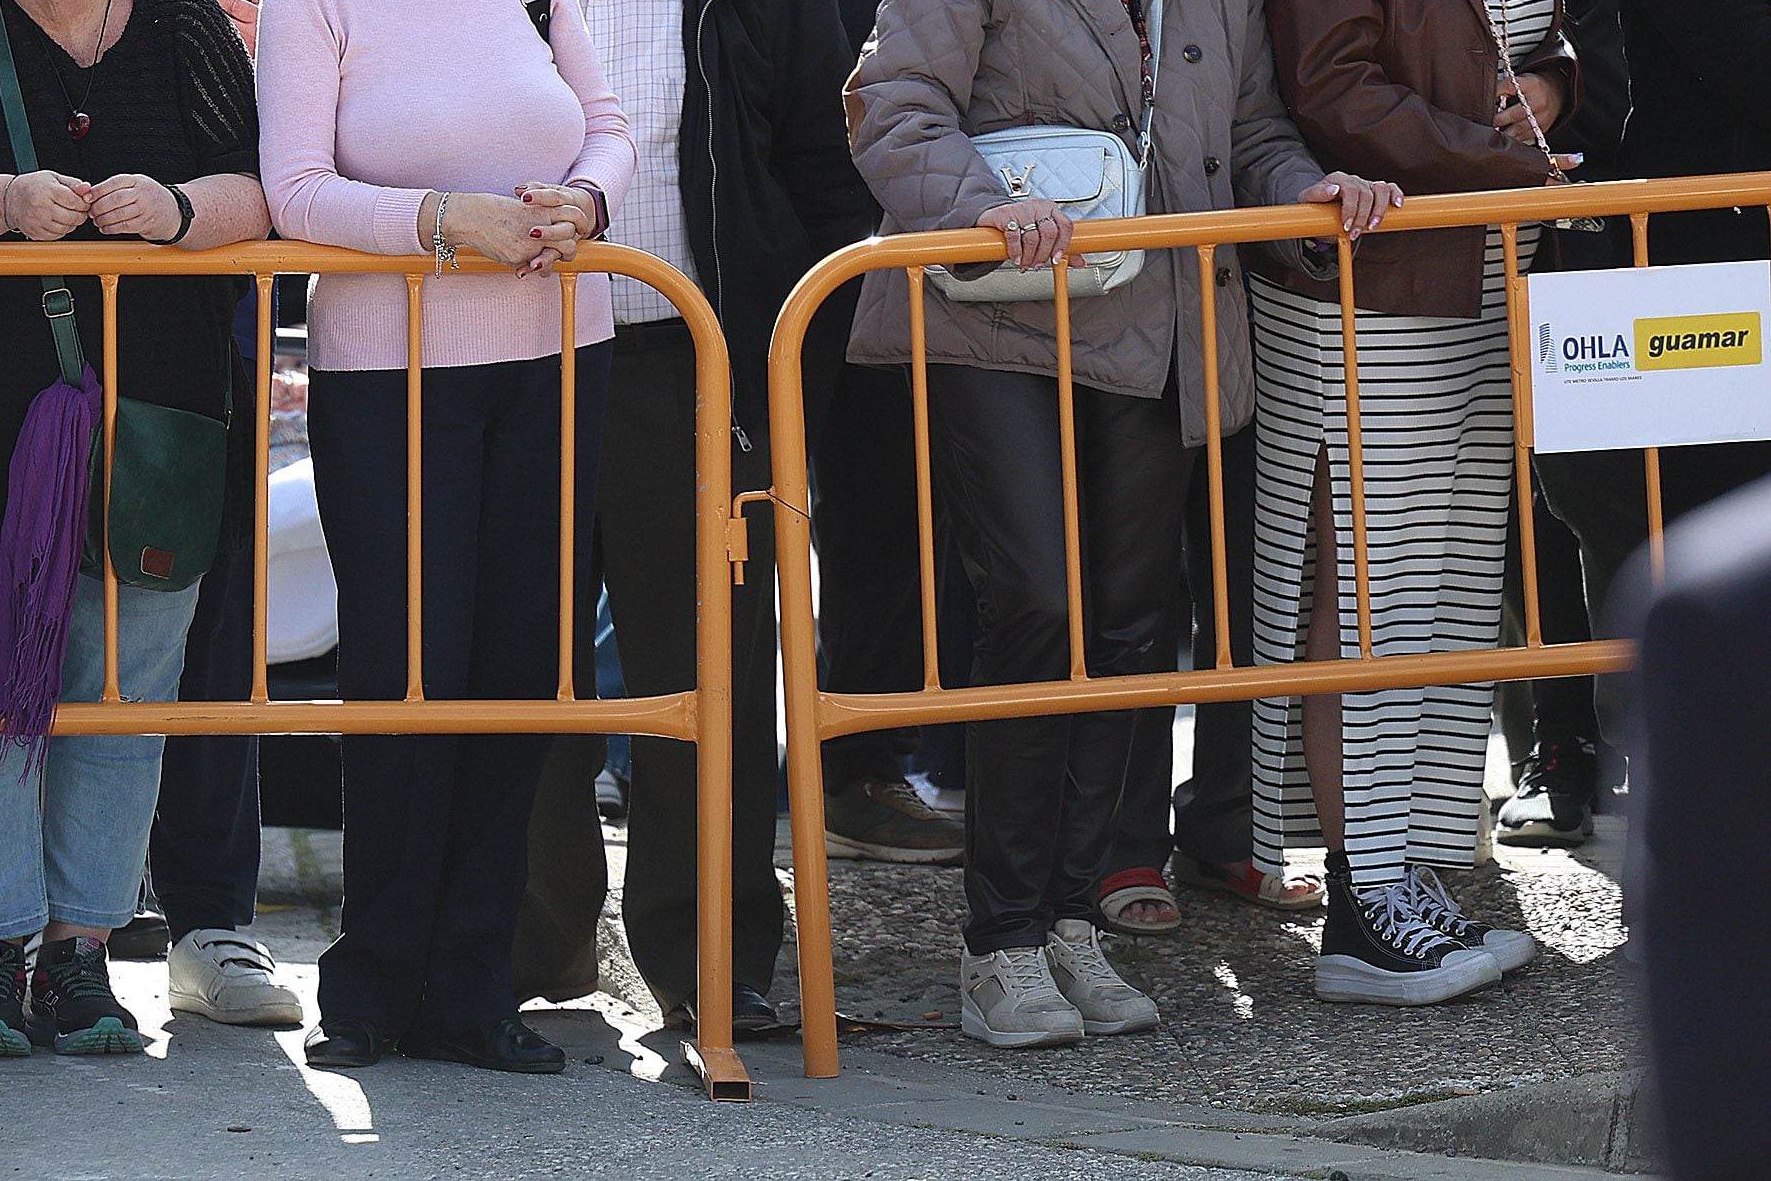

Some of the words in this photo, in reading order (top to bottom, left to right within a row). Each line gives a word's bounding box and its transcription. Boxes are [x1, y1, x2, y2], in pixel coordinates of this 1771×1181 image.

[1562, 334, 1630, 360] OHLA
[1648, 329, 1749, 358] guamar
[1564, 363, 1596, 374] Progress
[1598, 360, 1631, 370] Enablers
